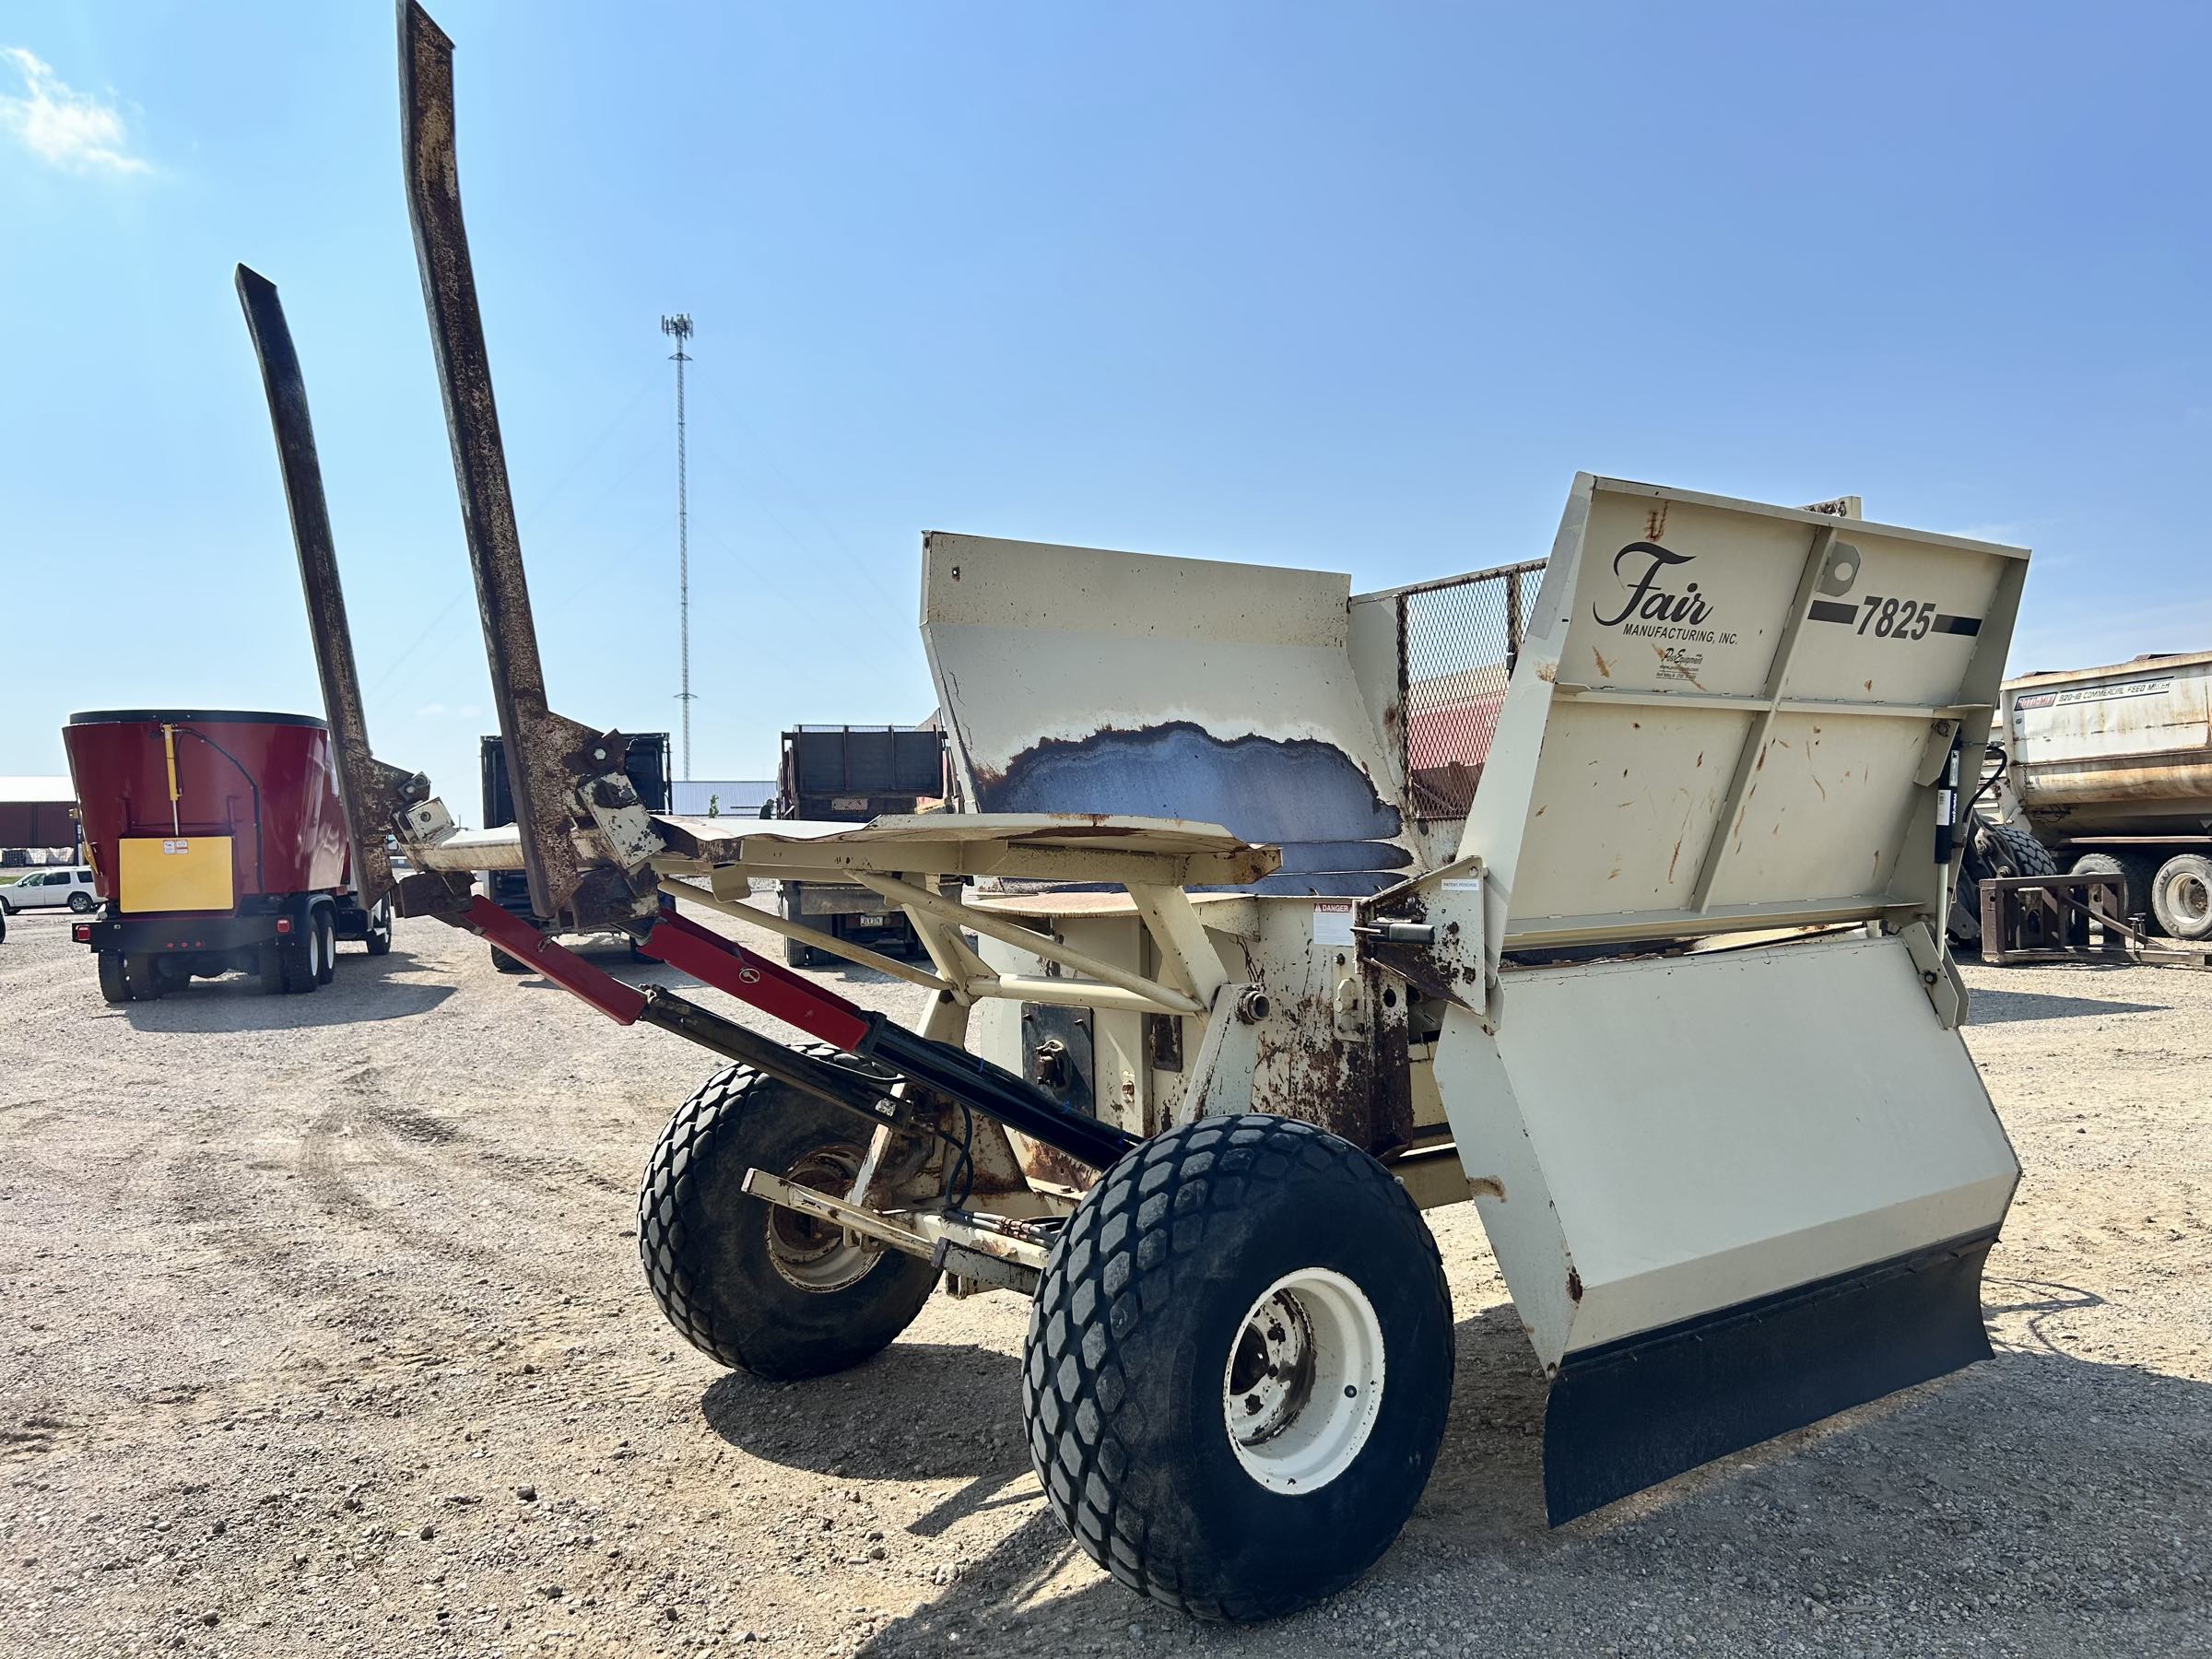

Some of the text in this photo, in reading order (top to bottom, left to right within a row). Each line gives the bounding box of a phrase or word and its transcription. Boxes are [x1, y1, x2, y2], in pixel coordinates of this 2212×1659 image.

[1593, 541, 1714, 626] Fair
[1622, 623, 1738, 645] MANUFACTURING, INC.
[1856, 595, 1936, 641] 7825
[1322, 904, 1349, 912] DANGER
